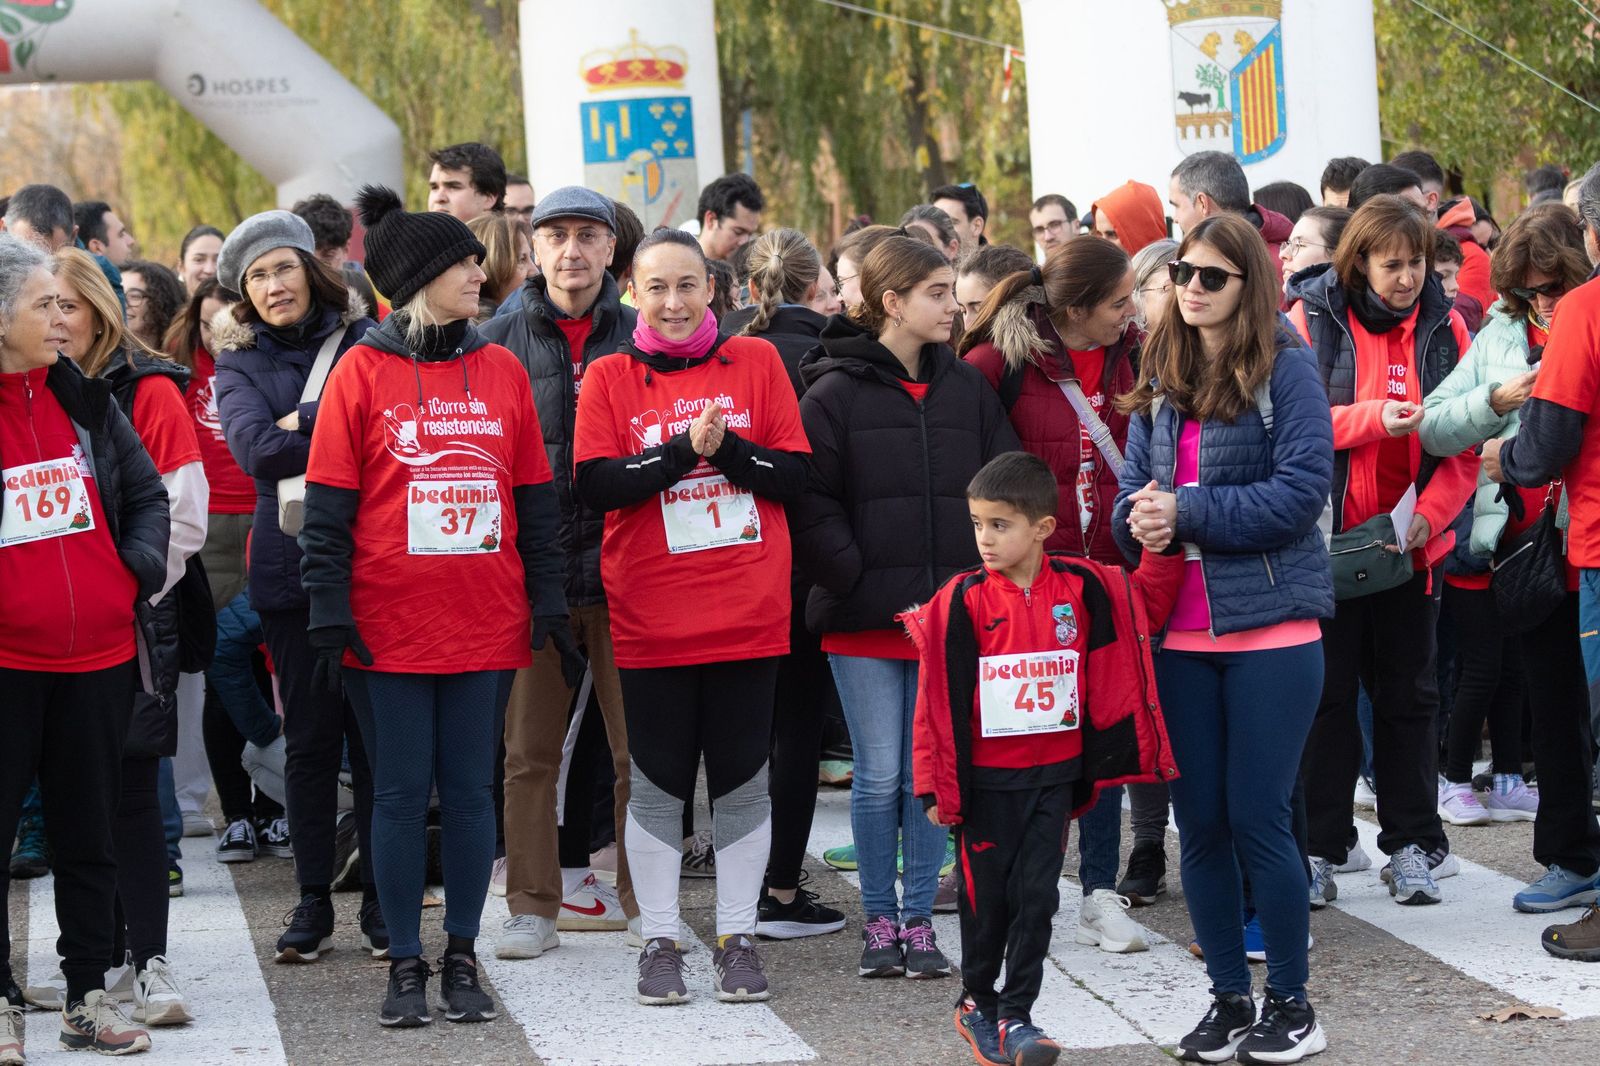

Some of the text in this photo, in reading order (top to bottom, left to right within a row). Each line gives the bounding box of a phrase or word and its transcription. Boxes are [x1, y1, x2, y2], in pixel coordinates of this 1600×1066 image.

[212, 77, 291, 95] HOSPES
[427, 397, 488, 417] ¡Corre sin
[422, 416, 504, 438] resistencias!
[6, 463, 80, 490] edunia
[15, 486, 71, 522] 169
[411, 485, 499, 504] bedunia
[440, 507, 478, 536] 37
[706, 501, 721, 529] 1
[982, 656, 1075, 681] bedunia
[1014, 681, 1055, 713] 45
